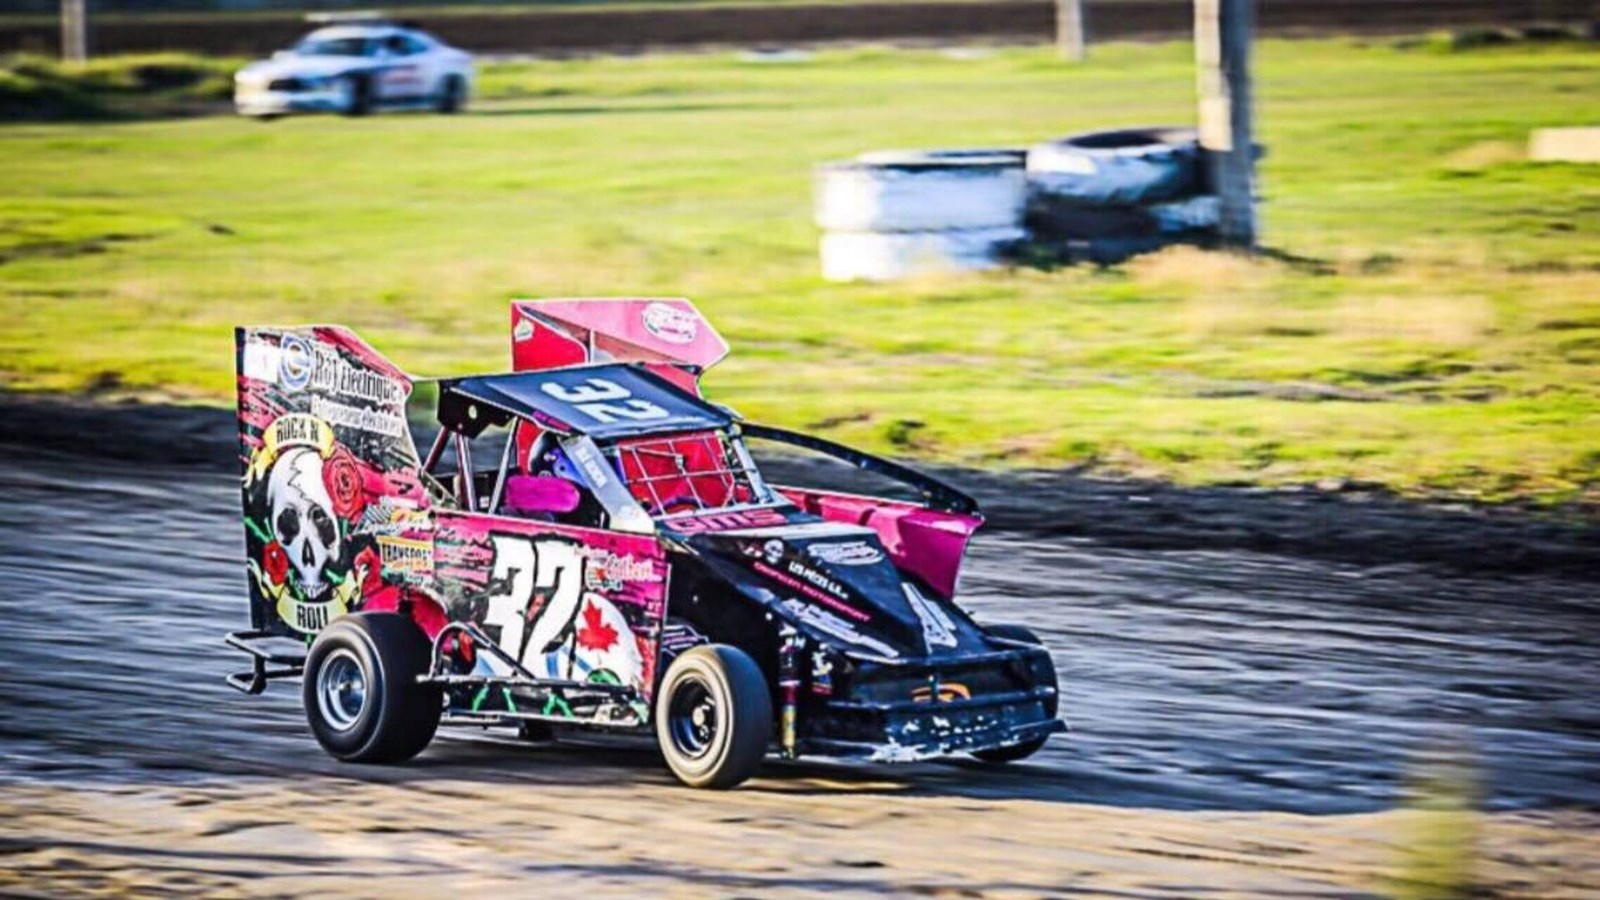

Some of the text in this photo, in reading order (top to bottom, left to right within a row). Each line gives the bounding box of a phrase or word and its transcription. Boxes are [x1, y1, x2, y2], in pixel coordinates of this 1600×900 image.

[541, 378, 669, 424] 32
[276, 417, 306, 444] ROCK
[482, 534, 583, 681] 32
